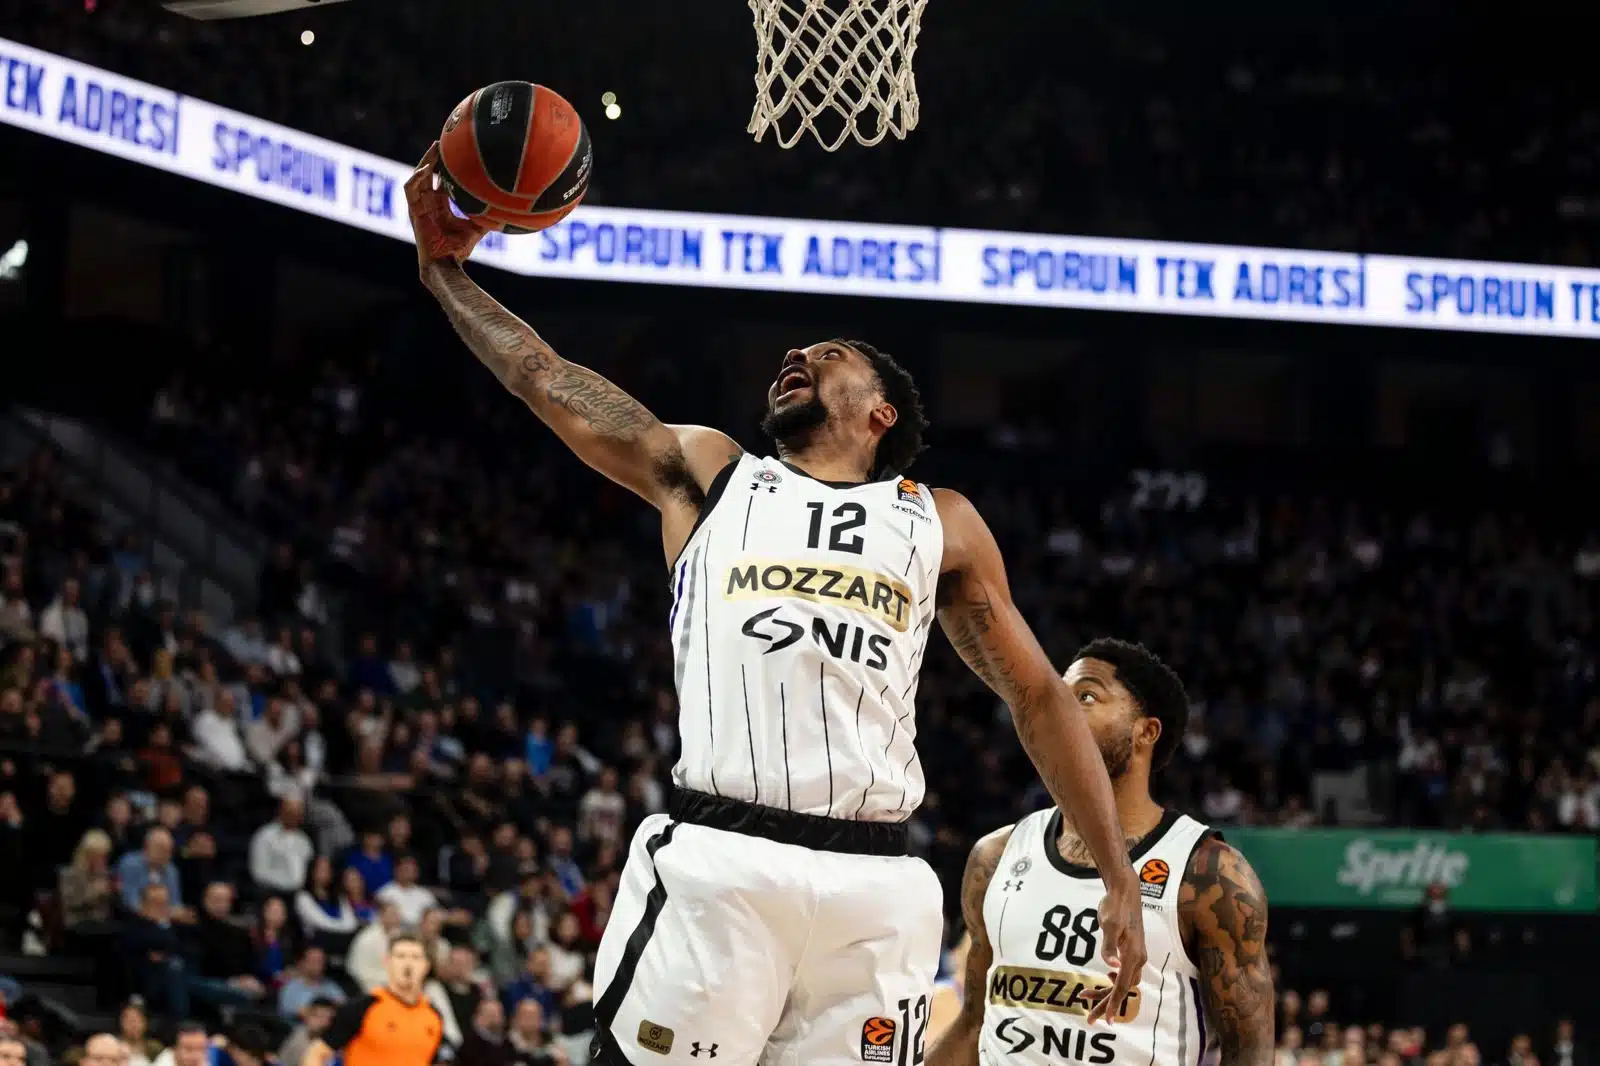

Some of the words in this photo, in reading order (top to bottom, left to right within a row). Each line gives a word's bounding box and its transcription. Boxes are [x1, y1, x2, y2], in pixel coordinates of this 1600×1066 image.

[211, 119, 338, 202] SPORUN
[351, 163, 396, 220] TEK
[540, 221, 703, 270] SPORUN
[720, 230, 784, 275] TEK
[981, 245, 1137, 296] SPORUN
[1155, 256, 1217, 300] TEK
[1404, 271, 1555, 320] SPORUN
[806, 501, 867, 555] 12
[726, 564, 911, 623] MOZZART
[812, 616, 892, 671] NIS
[1337, 838, 1470, 896] Sprite
[1035, 904, 1100, 967] 88
[989, 974, 1138, 1017] MOZZAT
[898, 994, 926, 1066] 12
[1042, 1025, 1117, 1065] NIS
